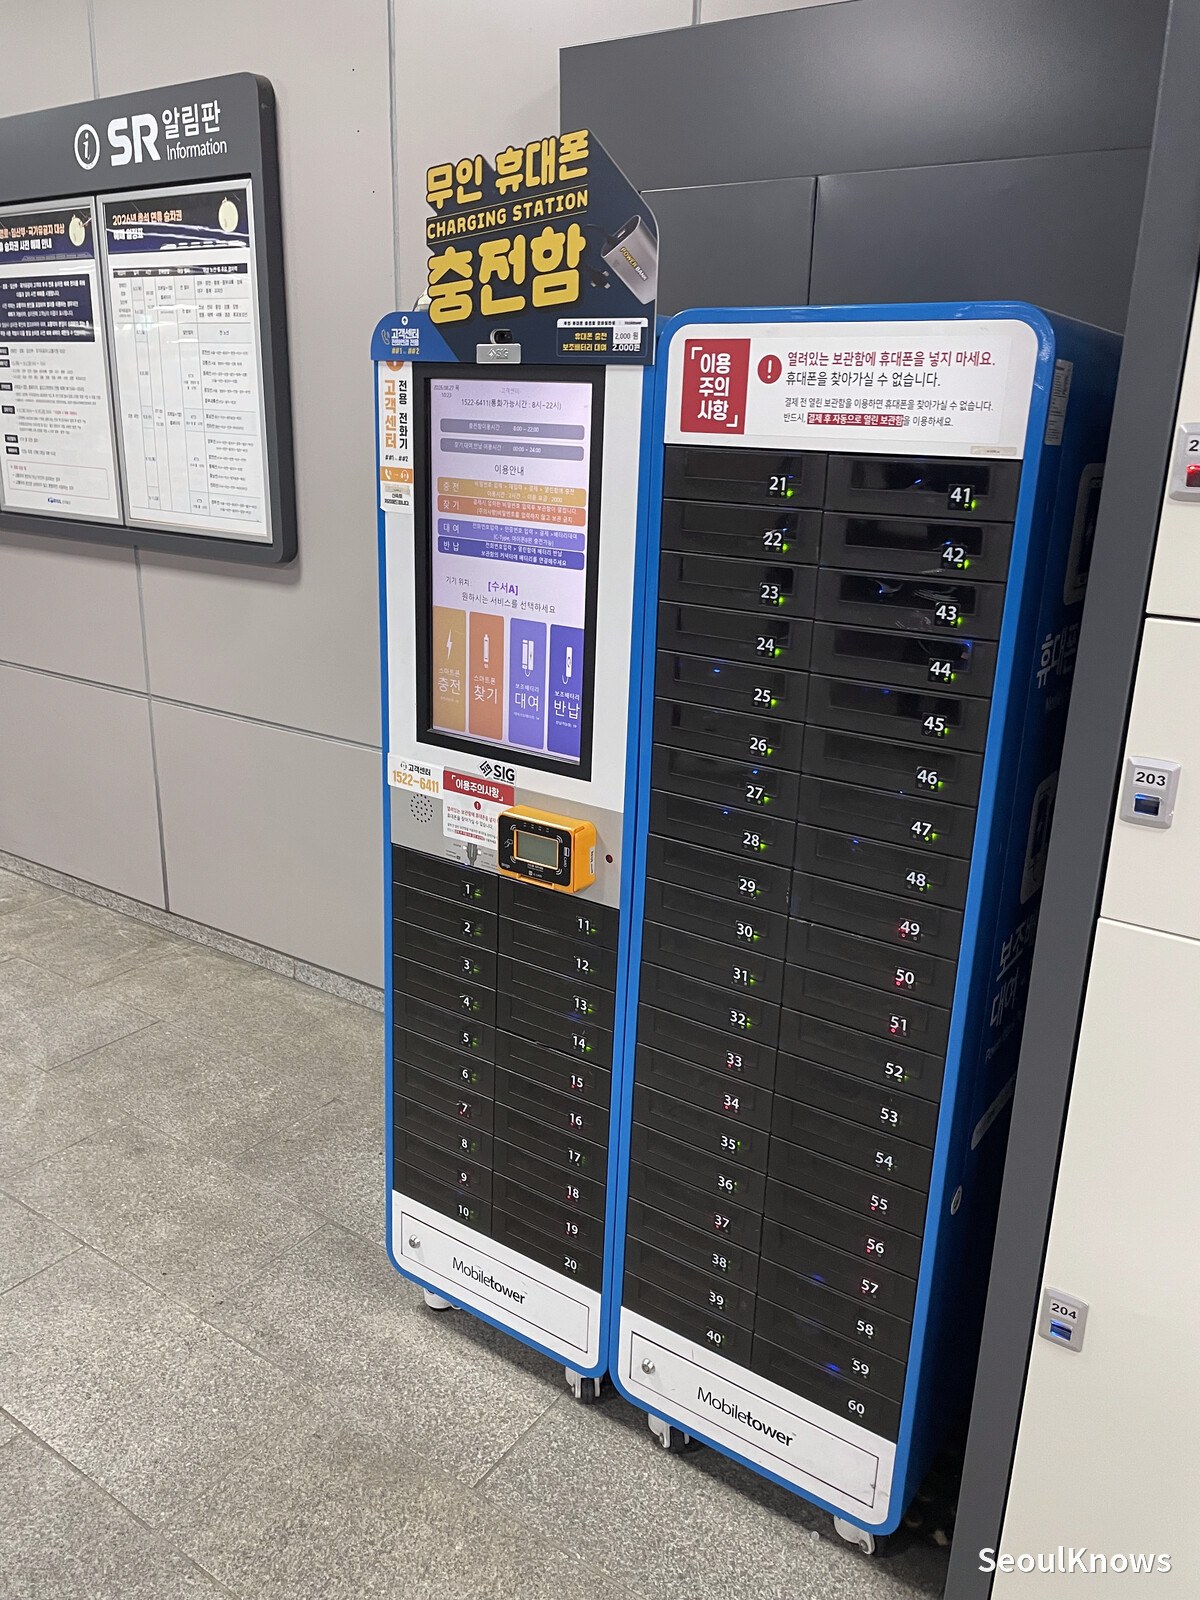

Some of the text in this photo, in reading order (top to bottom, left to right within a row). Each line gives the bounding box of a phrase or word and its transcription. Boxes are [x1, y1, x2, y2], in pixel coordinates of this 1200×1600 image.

[107, 100, 221, 167] SR 알림판
[166, 138, 228, 161] Information
[426, 128, 589, 210] 무인 휴대폰
[427, 189, 588, 240] CHARGING STATION
[427, 222, 587, 324] 충전함
[391, 328, 419, 339] 고객센터
[574, 332, 593, 341] 휴대폰
[594, 332, 608, 341] 충전
[562, 343, 593, 352] 보조배터리
[594, 343, 607, 352] 대여
[788, 351, 996, 367] 열려있는 보관함에 휴대폰을 넣지 마세요.
[698, 376, 730, 398] 주의
[786, 371, 941, 388] 휴대폰을 찾아가실 수 없습니다.
[784, 397, 994, 412] 결제 전 열린 보관함을 이용하면 휴대폰을 찾아가실 수 없습니다.
[384, 379, 397, 449] 고객센터
[398, 380, 408, 450] 전용 전화기
[783, 413, 806, 424] 반드시,
[808, 414, 823, 424] 결제
[824, 414, 832, 424] 후
[833, 414, 862, 425] 자동으로
[863, 414, 879, 425] 열린
[912, 416, 953, 428] 이용하세요.
[494, 464, 525, 476] 이용안내
[770, 476, 787, 491] 21
[950, 487, 971, 503] 41
[764, 532, 782, 546] 22
[943, 547, 964, 562] 42
[446, 575, 457, 585] 기기
[487, 581, 519, 596] [수서A]
[761, 585, 779, 599] 23
[461, 591, 556, 614] 원하시는 서비스를 선택하세요
[936, 605, 957, 620] 43
[756, 637, 774, 651] 24
[439, 667, 460, 678] 스마트폰
[930, 661, 951, 676] 44
[437, 676, 461, 695] 충전
[473, 675, 496, 686] 스마트폰
[515, 683, 540, 693] 보조배터리
[473, 685, 498, 705] 찾기
[514, 692, 539, 712] 대여
[554, 690, 580, 701] 보조배터리
[754, 688, 770, 703] 25
[553, 699, 581, 720] 반납
[924, 716, 945, 732] 45
[750, 737, 767, 751] 26
[408, 763, 431, 777] 고객센터
[493, 764, 515, 782] SIG
[917, 769, 938, 785] 46
[392, 769, 440, 794] 1522-6411
[1135, 771, 1166, 787] 203
[746, 785, 763, 799] 27
[911, 821, 932, 836] 47
[743, 832, 760, 847] 28
[739, 878, 756, 893] 29
[906, 871, 926, 887] 48
[466, 884, 470, 895] 1
[464, 922, 471, 933] 2
[578, 918, 590, 931] 11
[736, 923, 753, 938] 30
[900, 920, 920, 936] 49
[464, 959, 470, 970] 3
[576, 958, 589, 971] 12
[733, 967, 748, 982] 31
[895, 969, 915, 985] 50
[463, 996, 470, 1007] 4
[574, 998, 587, 1011] 13
[730, 1010, 745, 1025] 32
[890, 1016, 907, 1031] 51
[463, 1032, 469, 1043] 5
[573, 1035, 586, 1049] 14
[727, 1053, 742, 1067] 33
[462, 1069, 469, 1079] 6
[885, 1062, 903, 1078] 52
[571, 1075, 583, 1088] 15
[462, 1103, 468, 1114] 7
[724, 1094, 739, 1109] 34
[570, 1113, 582, 1126] 16
[880, 1106, 898, 1123] 53
[461, 1139, 468, 1149] 8
[720, 1135, 736, 1150] 35
[568, 1150, 581, 1163] 17
[875, 1151, 893, 1168] 54
[460, 1172, 467, 1182] 9
[717, 1175, 733, 1190] 36
[567, 1186, 579, 1199] 18
[870, 1194, 888, 1211] 55
[458, 1205, 469, 1217] 10
[565, 1222, 578, 1235] 19
[714, 1214, 730, 1229] 37
[866, 1238, 884, 1254] 56
[564, 1257, 577, 1270] 20
[711, 1253, 727, 1268] 38
[452, 1256, 526, 1305] Mobiletower
[861, 1278, 879, 1294] 57
[709, 1291, 724, 1306] 39
[1051, 1302, 1077, 1320] 204
[856, 1320, 874, 1336] 58
[706, 1329, 721, 1344] 40
[851, 1360, 869, 1375] 59
[847, 1400, 865, 1415] 60
[696, 1386, 794, 1447] Mobiletower
